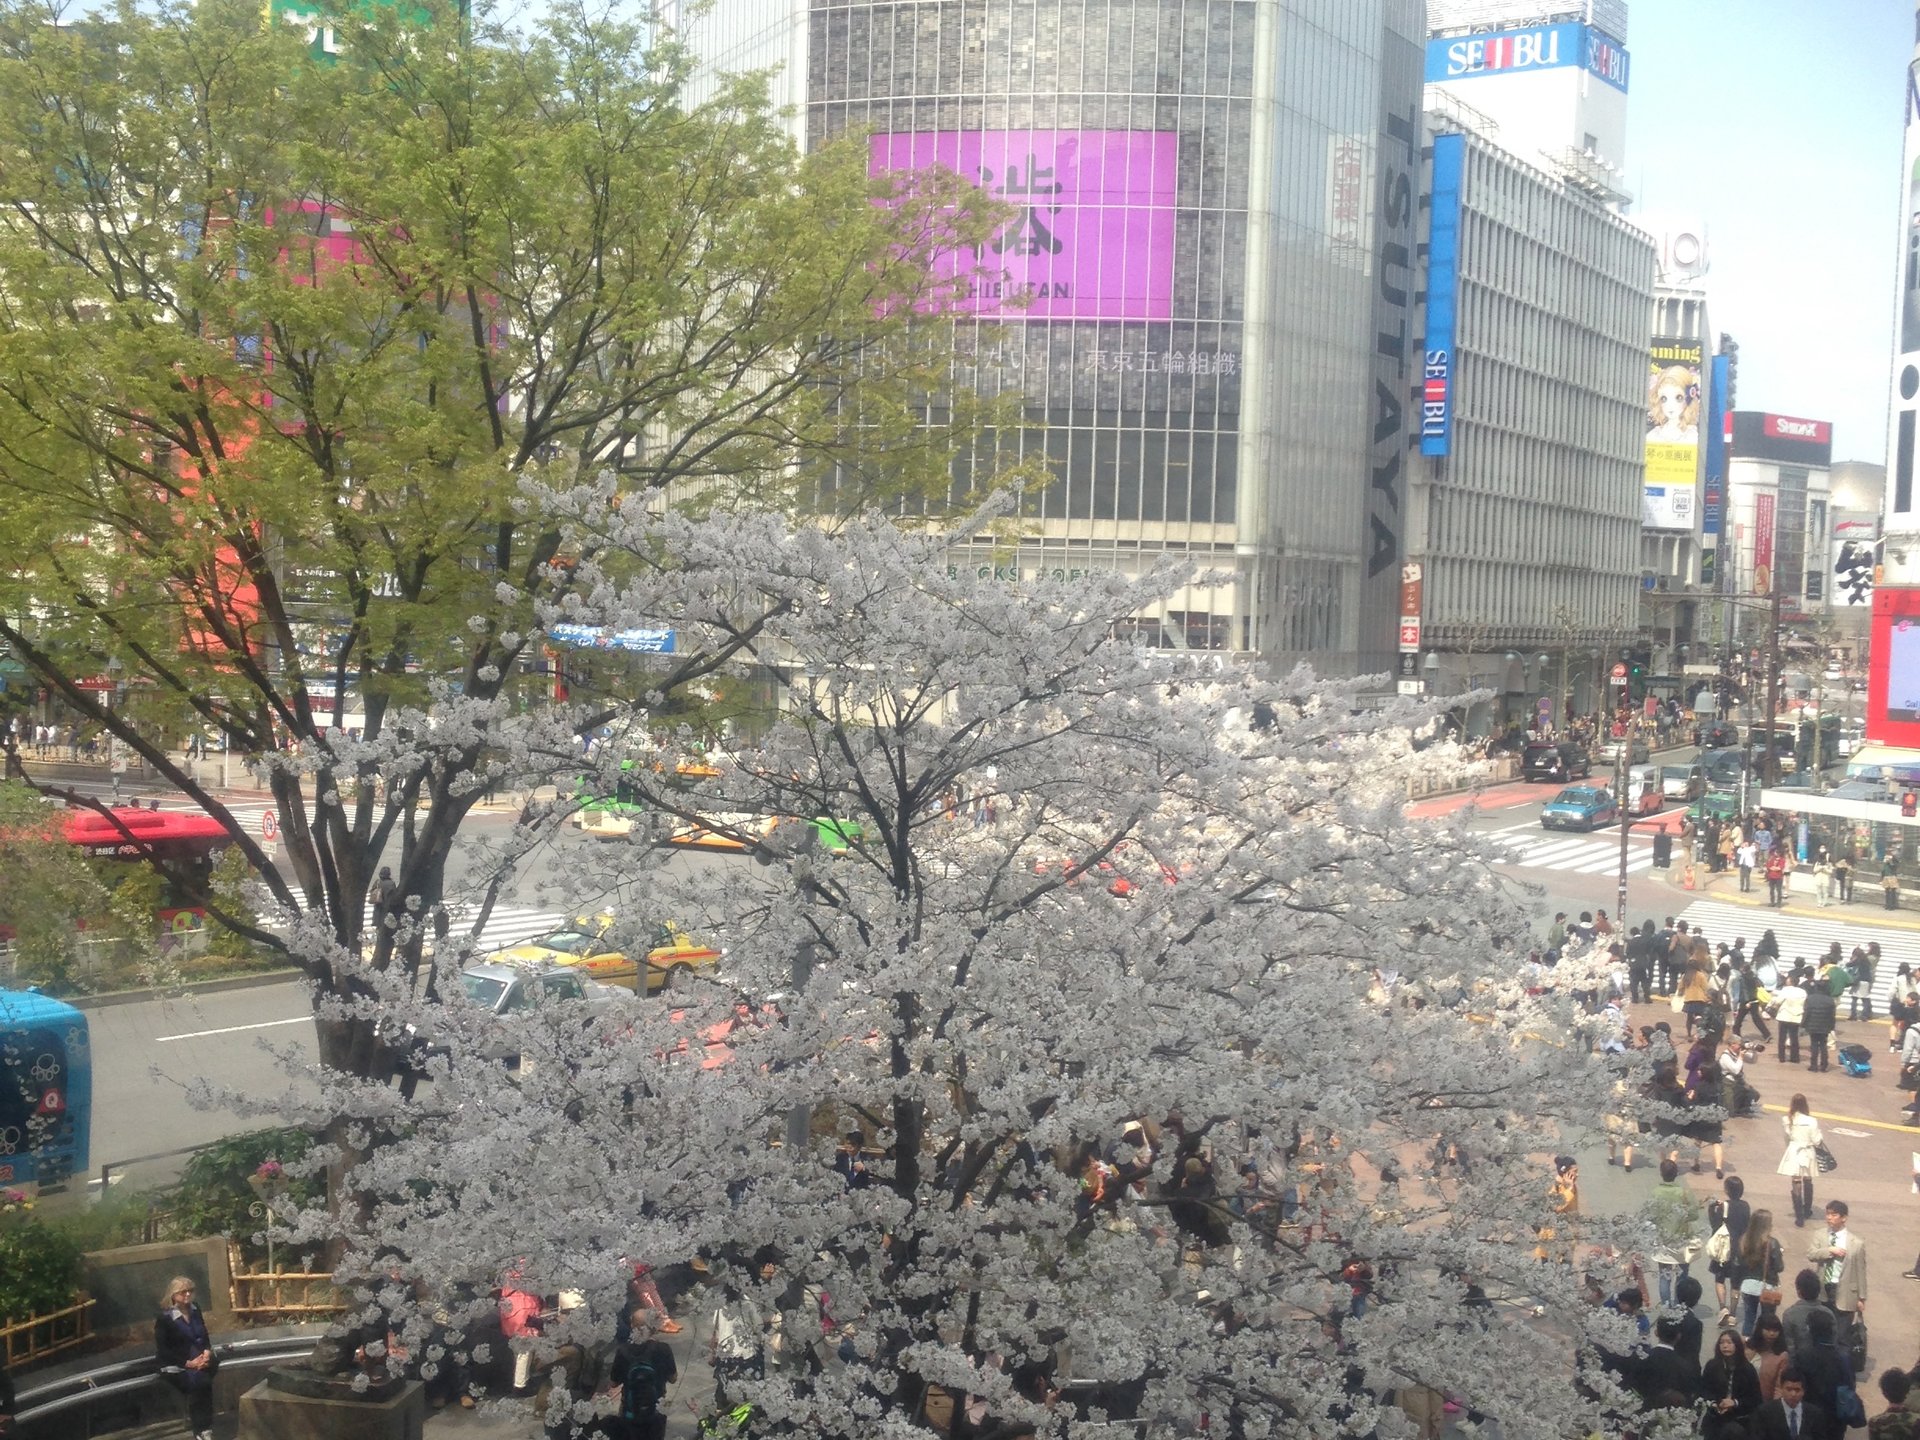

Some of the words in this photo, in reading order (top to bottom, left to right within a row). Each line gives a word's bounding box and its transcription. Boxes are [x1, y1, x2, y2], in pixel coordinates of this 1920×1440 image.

[1447, 30, 1560, 75] SEIBU
[1588, 35, 1627, 86] SEIBU
[1369, 104, 1416, 578] TSUTAYA
[1423, 350, 1448, 436] SEIBU
[1705, 474, 1721, 523] SEIBU
